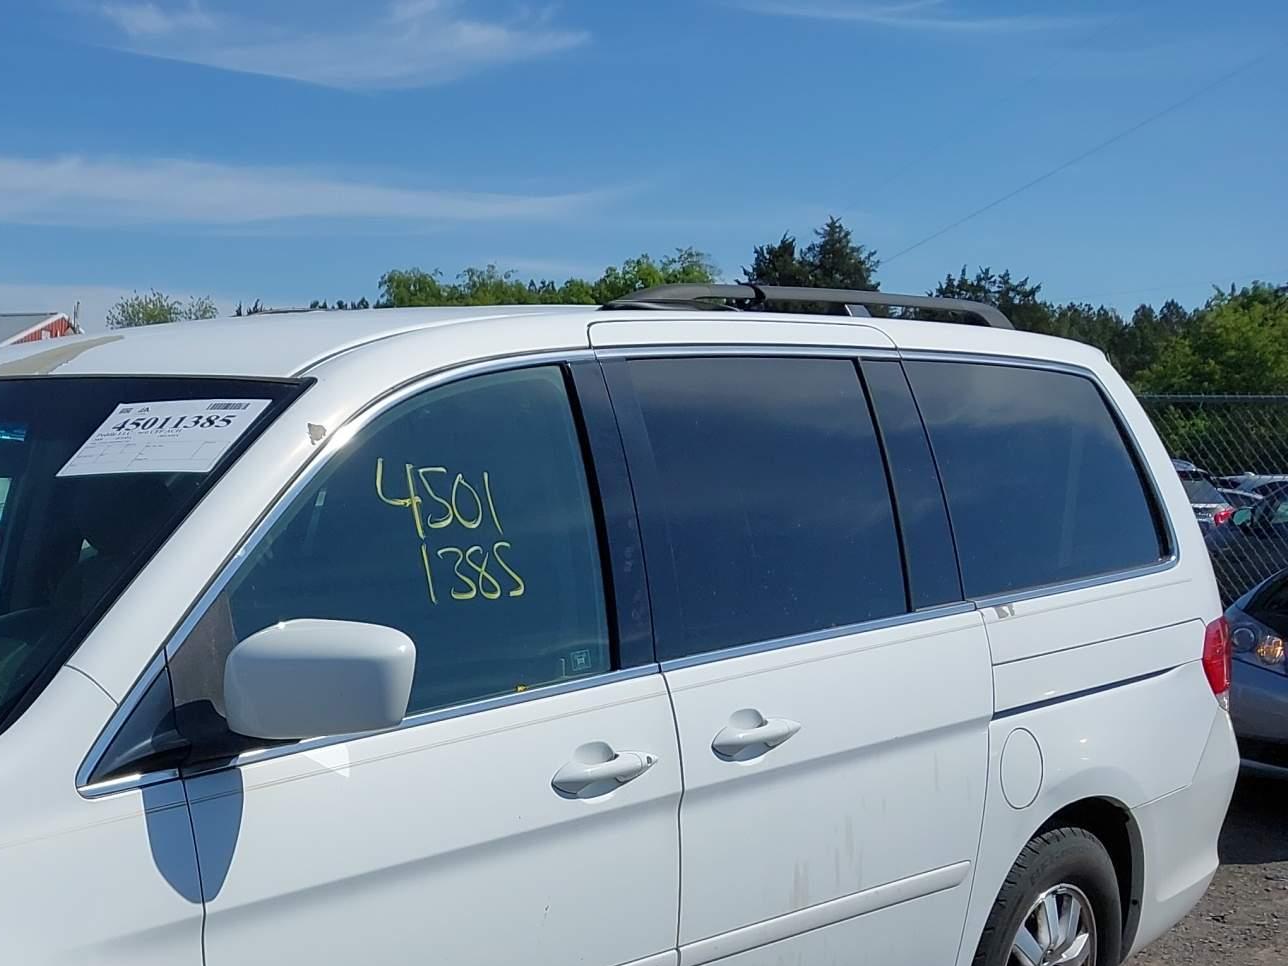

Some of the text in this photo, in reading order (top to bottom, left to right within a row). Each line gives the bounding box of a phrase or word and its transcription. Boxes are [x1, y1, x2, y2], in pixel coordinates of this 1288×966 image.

[112, 414, 237, 432] 45011385
[375, 457, 504, 540] 4501
[421, 542, 525, 605] 1385
